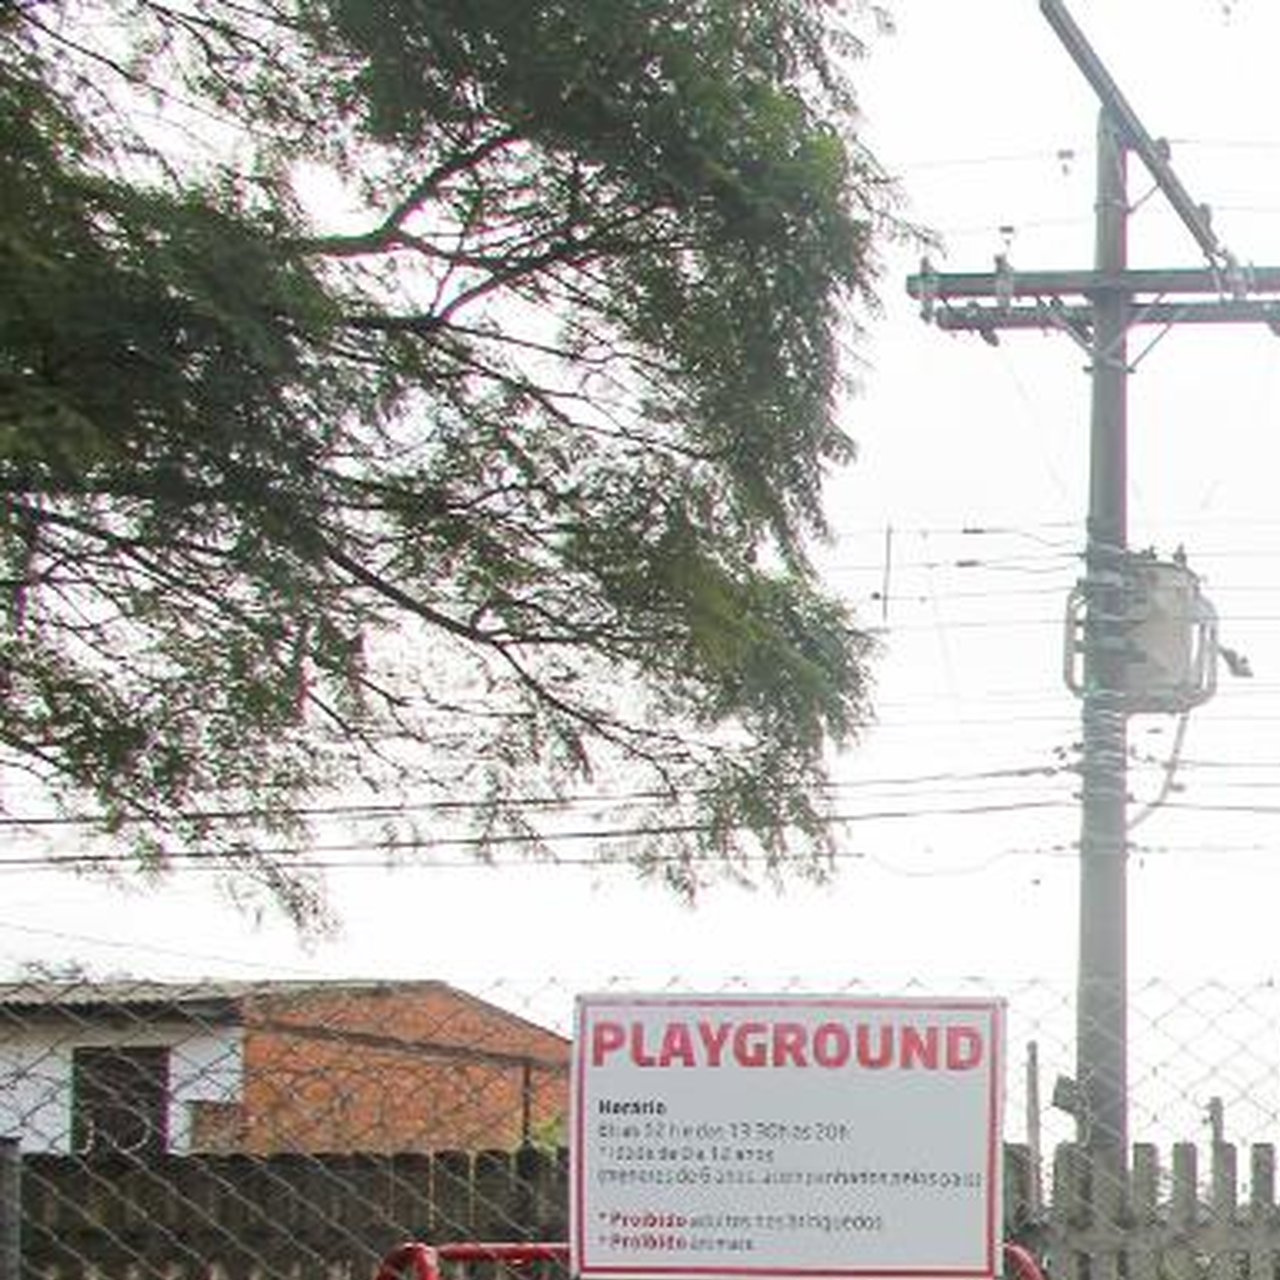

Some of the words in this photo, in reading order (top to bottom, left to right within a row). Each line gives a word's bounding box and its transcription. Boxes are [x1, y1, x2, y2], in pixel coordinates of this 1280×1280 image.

[592, 1022, 984, 1070] PLAYGROUND
[611, 1212, 688, 1228] Proibido
[611, 1233, 688, 1250] Proibido
